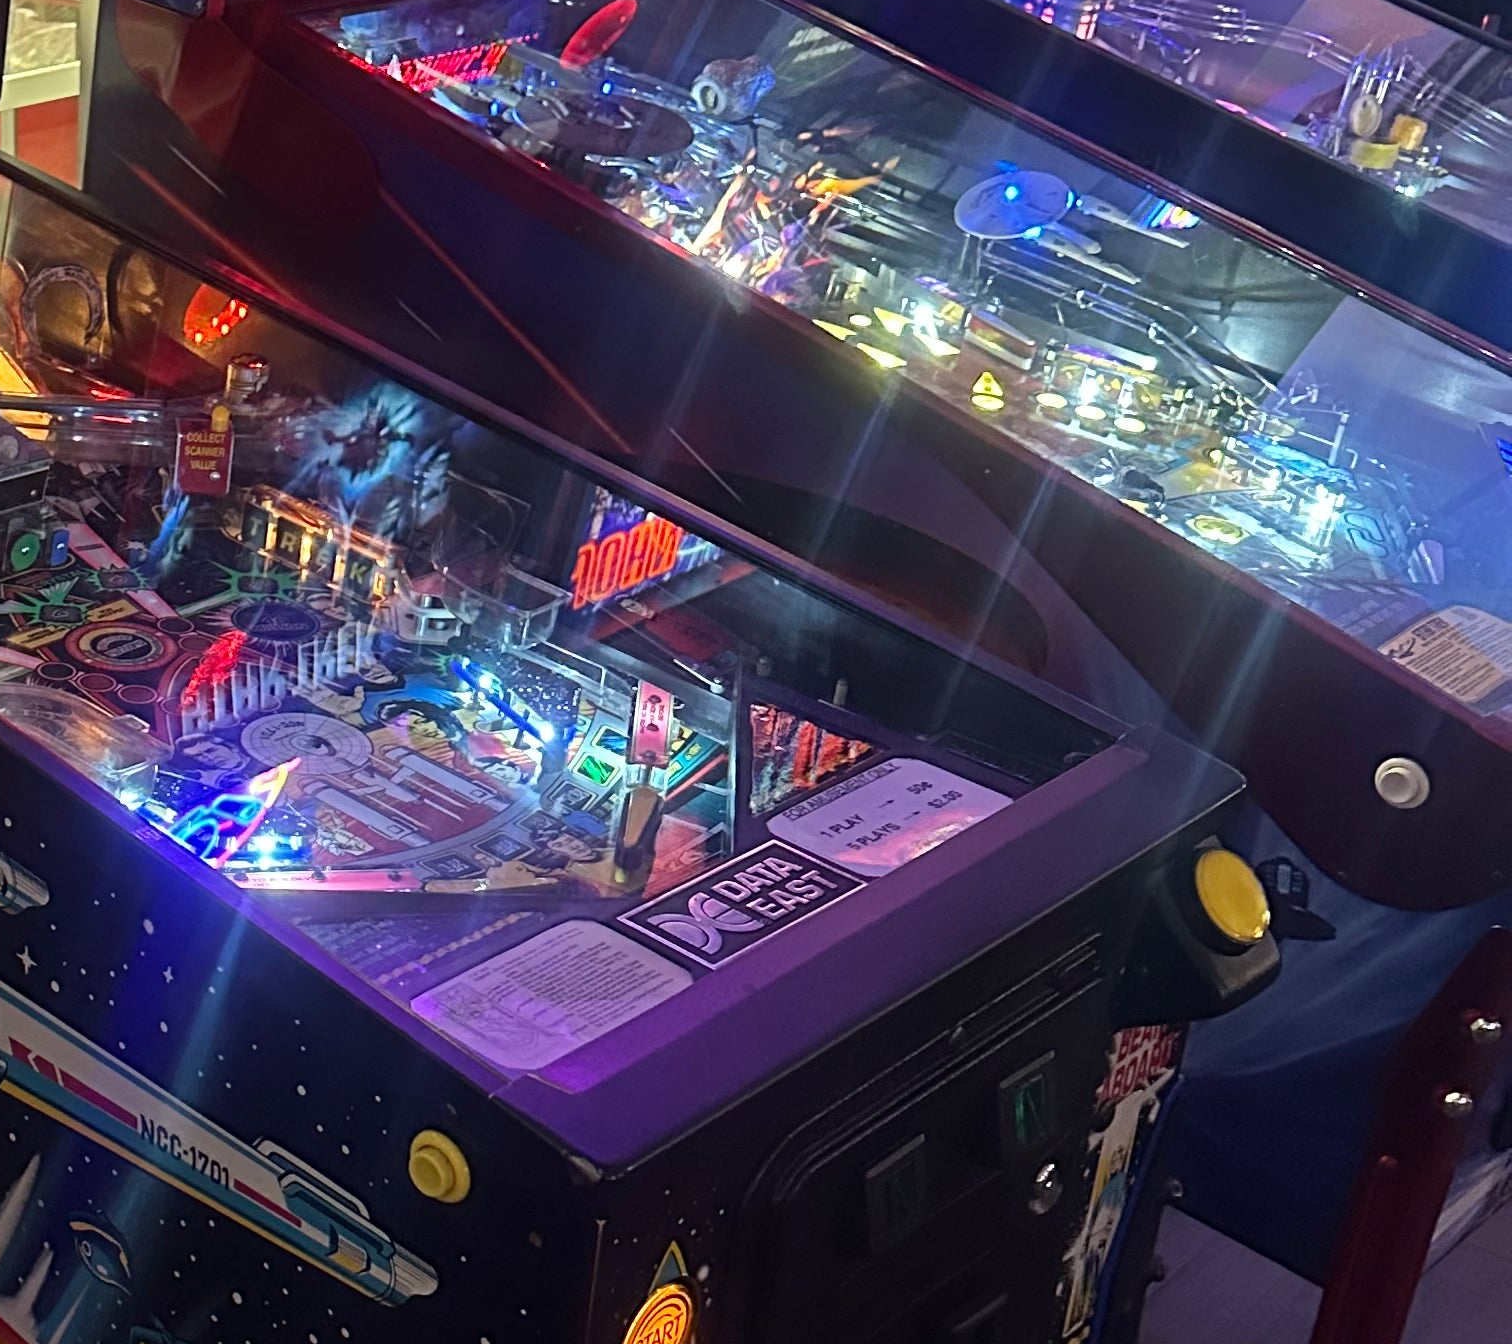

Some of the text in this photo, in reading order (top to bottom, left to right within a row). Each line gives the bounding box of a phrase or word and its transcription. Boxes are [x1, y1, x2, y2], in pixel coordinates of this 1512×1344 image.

[184, 445, 226, 458] SCANNER
[187, 432, 226, 444] COLLECT
[190, 459, 217, 471] VALUE
[782, 763, 902, 822] FOR AMUSEMENT ONLY
[829, 813, 866, 835] PLAY
[855, 822, 902, 846] PLAYS
[928, 789, 964, 809] $2.00
[711, 856, 804, 903] DATA
[746, 869, 838, 921] EAST
[138, 1114, 234, 1190] NCC-1701
